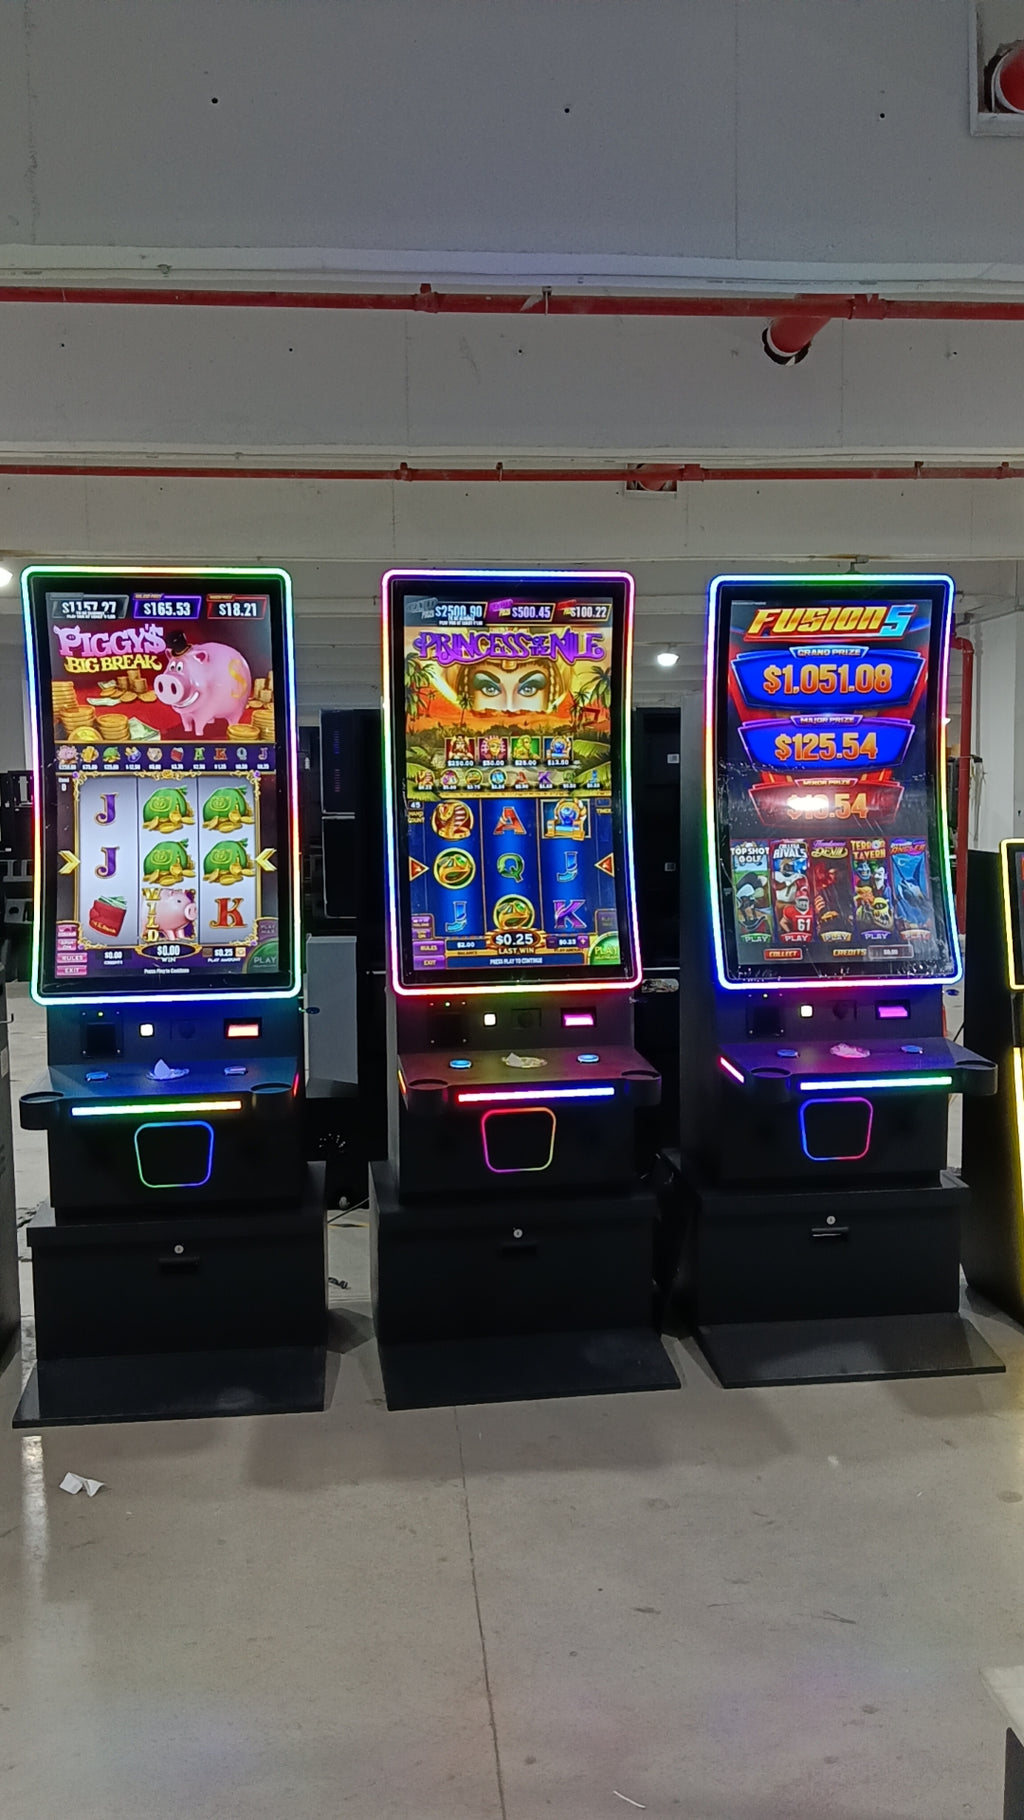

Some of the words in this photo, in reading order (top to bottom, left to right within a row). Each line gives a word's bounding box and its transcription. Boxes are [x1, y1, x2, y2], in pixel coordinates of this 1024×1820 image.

[62, 601, 117, 614] $115727
[144, 602, 191, 616] $165.53
[219, 603, 257, 616] $18.21
[512, 606, 551, 618] $500.45
[570, 606, 607, 618] $100.22
[413, 631, 530, 665] PRINCESS
[550, 629, 605, 663] NILE
[832, 648, 861, 656] PRIZE
[64, 656, 99, 674] BIG
[100, 654, 162, 672] BREAK
[763, 663, 893, 695] $1,051.08
[775, 732, 878, 760] $125.54
[194, 747, 205, 760] A
[214, 748, 227, 760] K
[95, 793, 119, 826] J
[493, 806, 527, 835] A
[738, 855, 761, 863] GOLF
[773, 848, 807, 859] RIVALS
[853, 850, 886, 859] TAVERN
[95, 846, 119, 879] J
[496, 853, 525, 882] Q
[557, 851, 579, 882] J
[142, 888, 161, 941] WILD
[209, 898, 248, 928] K
[445, 901, 468, 932] J
[553, 899, 587, 929] K
[797, 918, 811, 931] 61
[495, 933, 533, 945] $0.25
[104, 951, 123, 959] $0.00
[157, 945, 181, 956] $0.00
[498, 947, 517, 955] LAST
[594, 946, 618, 955] PLAY
[253, 956, 277, 964] PLAY
